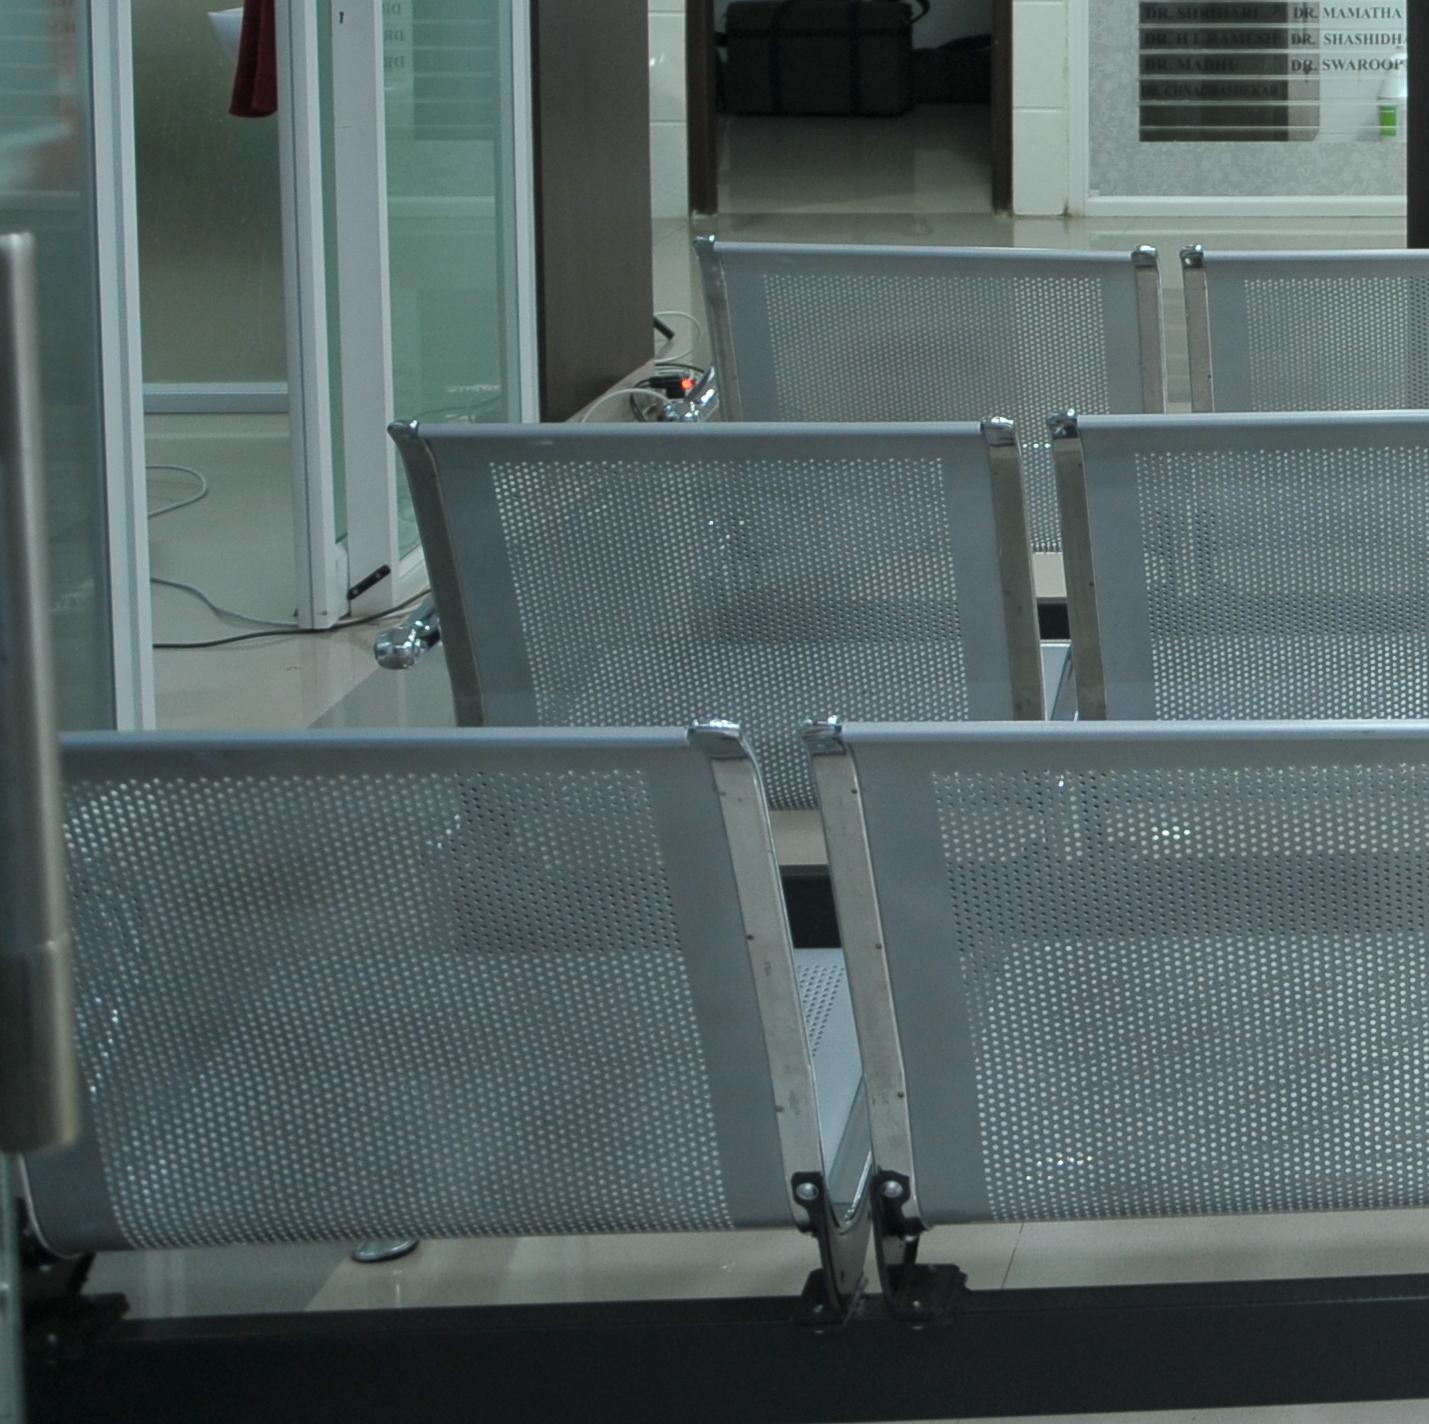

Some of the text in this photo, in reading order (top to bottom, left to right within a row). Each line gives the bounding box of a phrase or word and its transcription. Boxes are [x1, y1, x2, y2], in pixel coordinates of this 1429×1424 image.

[1293, 6, 1402, 19] DR. MAMATHA
[1291, 32, 1408, 46] DR. SHASHIDH
[1322, 58, 1404, 72] SWAROOP
